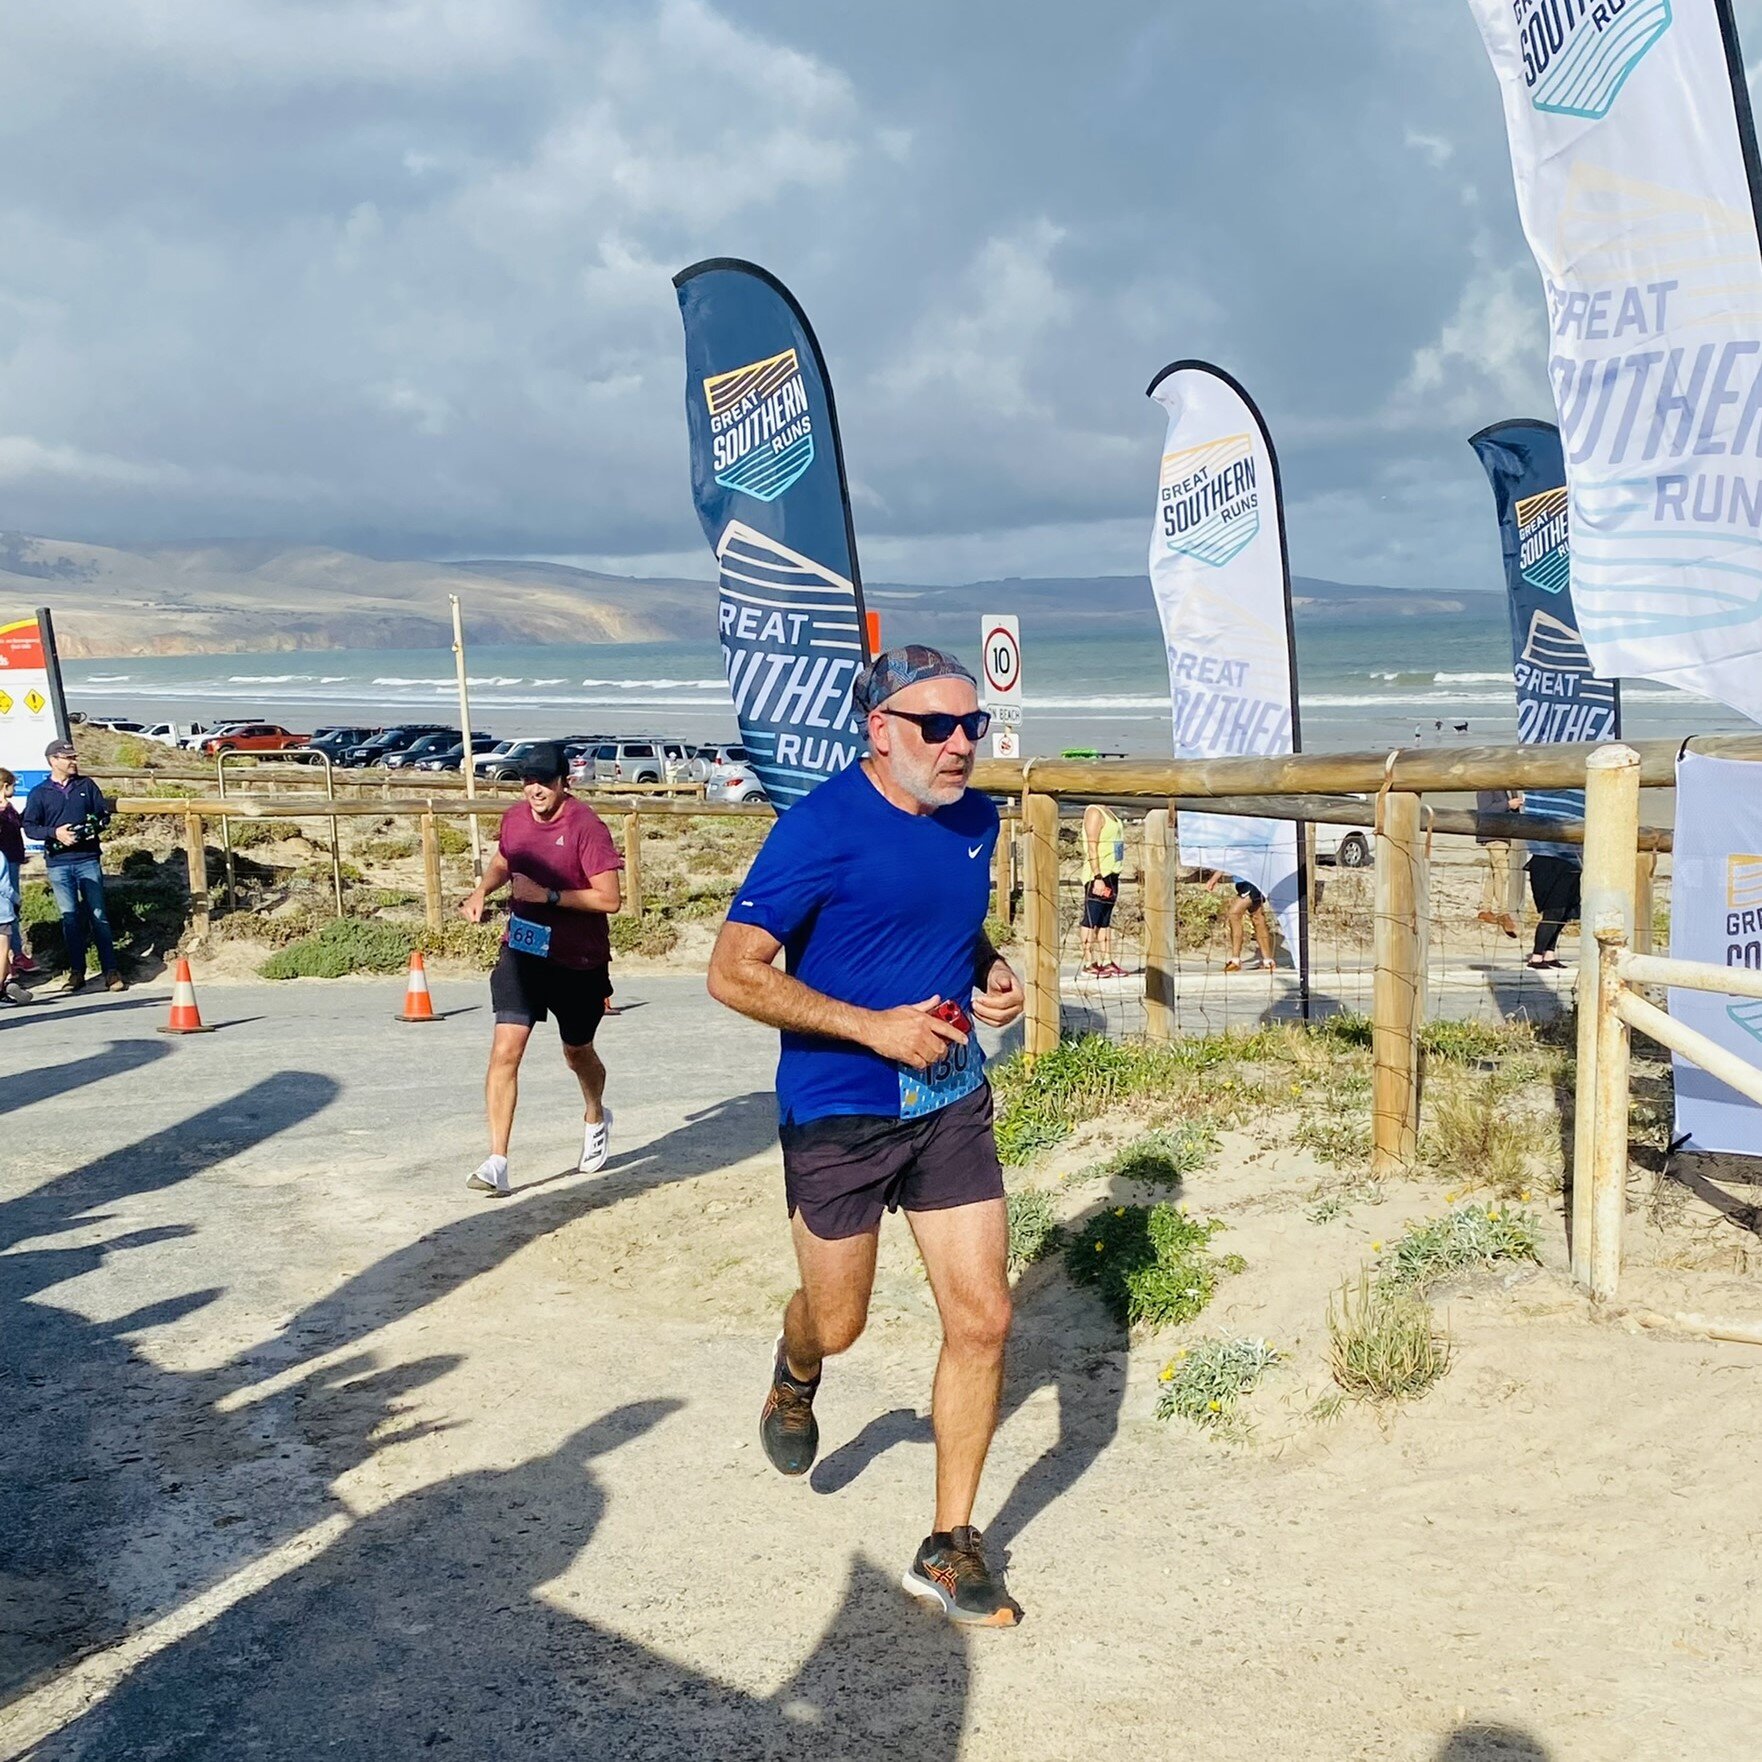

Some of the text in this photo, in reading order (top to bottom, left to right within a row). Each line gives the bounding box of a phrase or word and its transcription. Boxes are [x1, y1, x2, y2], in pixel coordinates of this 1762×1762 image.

[711, 388, 758, 433] GREAT
[713, 374, 808, 471] SOUTHERN
[772, 416, 811, 454] RUNS
[1162, 465, 1209, 501] GREAT
[1163, 456, 1256, 537] SOUTHERN
[1221, 494, 1258, 523] RUNS
[1519, 510, 1549, 541] GREAT
[993, 647, 1010, 674] 10
[722, 644, 865, 734] UTHE
[1514, 663, 1579, 697] GREAT
[999, 709, 1020, 720] BEACH
[776, 733, 870, 772] RUN
[514, 928, 534, 945] 68
